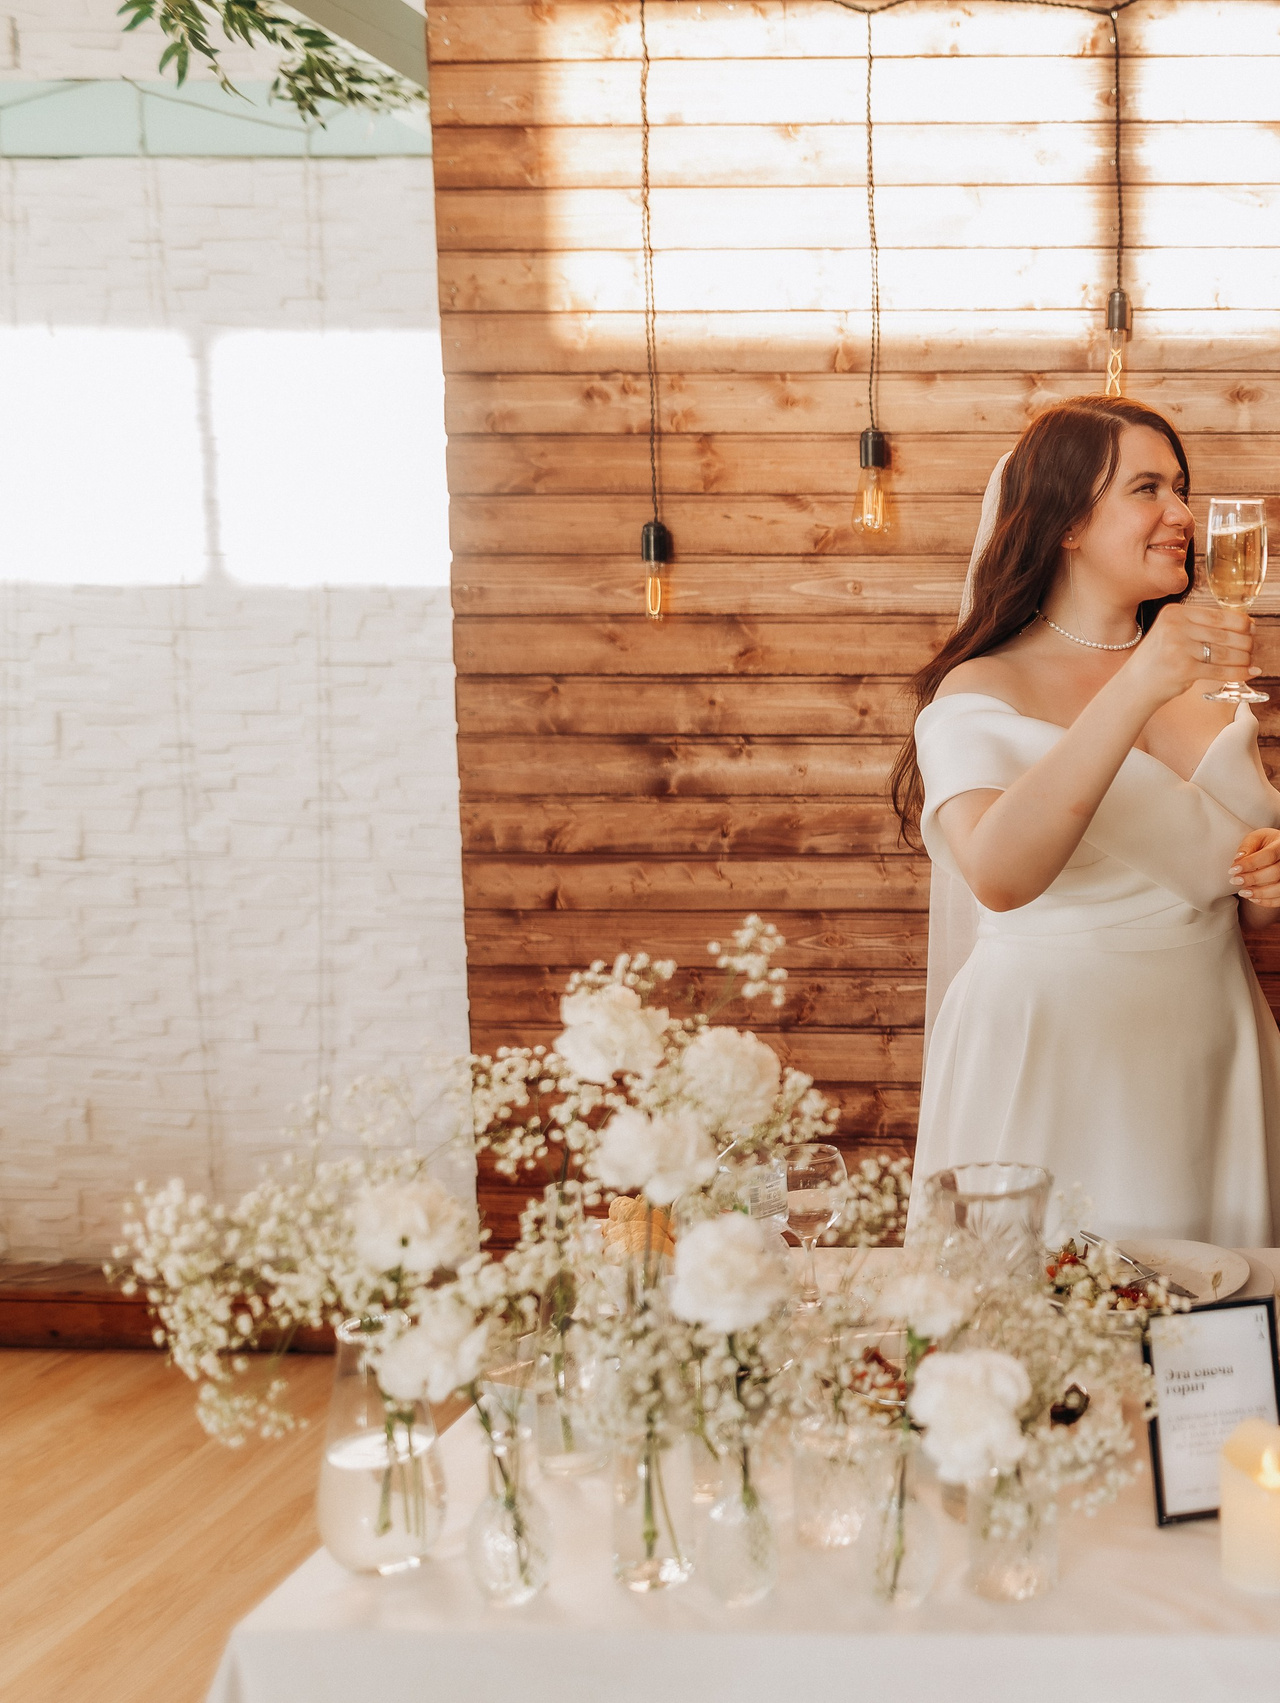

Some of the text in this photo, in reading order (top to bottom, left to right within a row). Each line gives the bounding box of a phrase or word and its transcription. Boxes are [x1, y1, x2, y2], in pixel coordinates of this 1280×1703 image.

[1165, 1364, 1234, 1380] Эта свеча
[1166, 1381, 1206, 1396] горит
